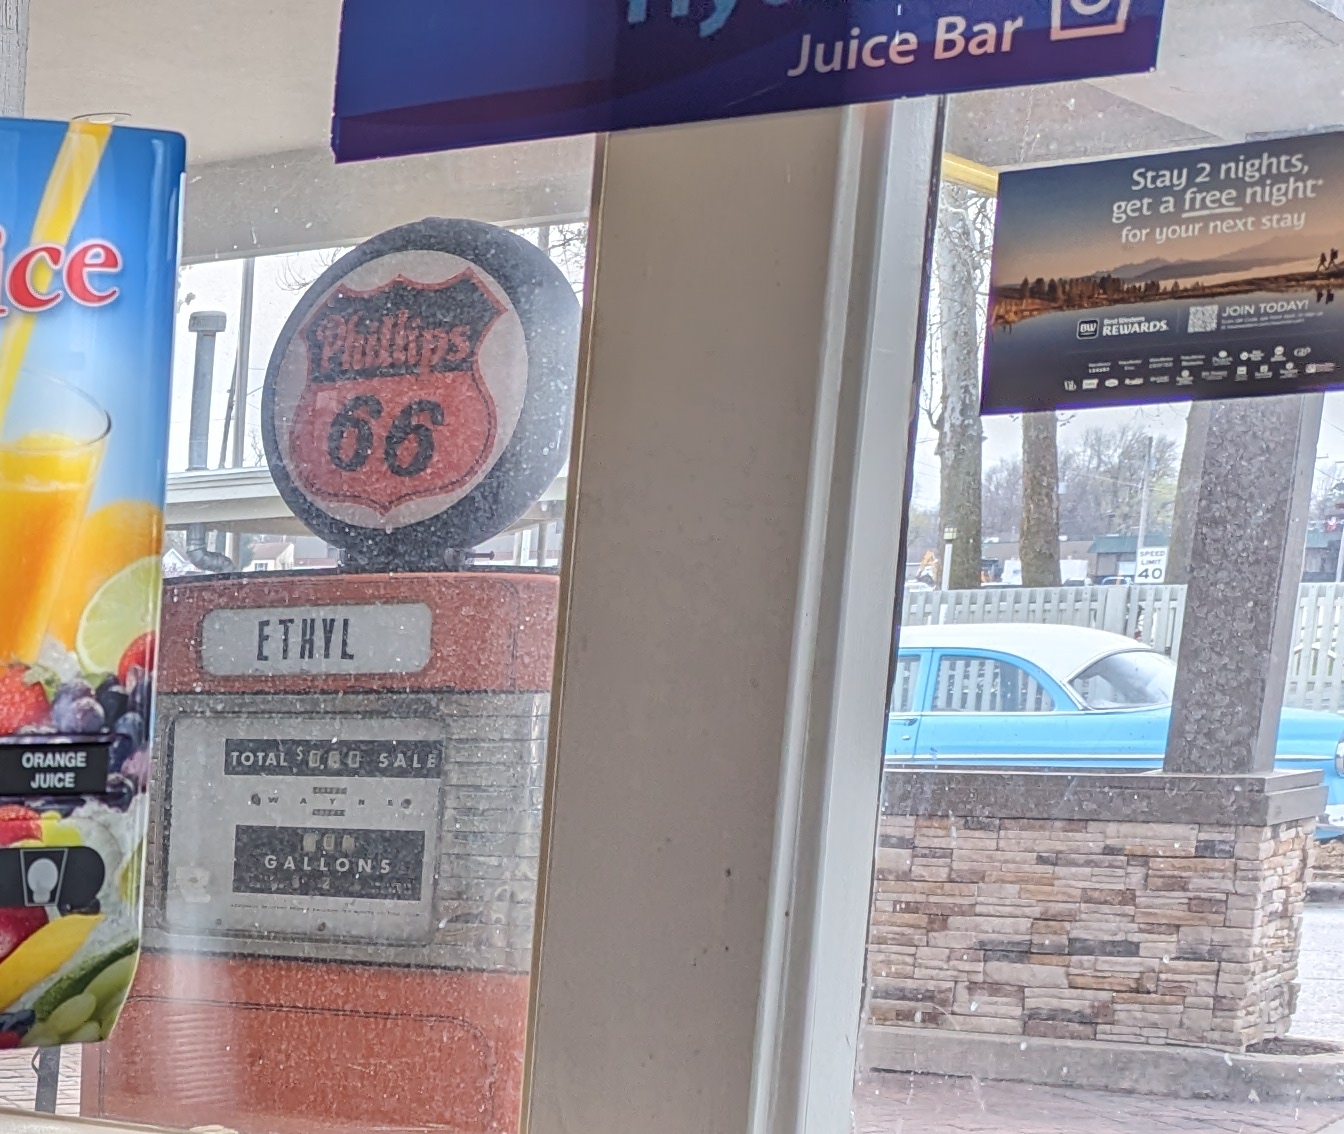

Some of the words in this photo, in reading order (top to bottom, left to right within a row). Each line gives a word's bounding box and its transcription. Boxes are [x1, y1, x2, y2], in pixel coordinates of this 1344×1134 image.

[787, 26, 919, 77] Juice
[933, 15, 1024, 60] Bar
[1131, 168, 1187, 191] Stay
[1195, 162, 1211, 183] 2
[1219, 152, 1310, 182] nights,
[1111, 196, 1153, 224] get
[1159, 196, 1175, 214] a
[1183, 187, 1237, 212] free
[1121, 226, 1150, 244] for
[1155, 221, 1203, 245] your
[1208, 217, 1255, 235] next
[1260, 211, 1306, 232] stay
[1221, 304, 1255, 318] JOIN
[1258, 299, 1310, 314] TODAY!
[1102, 320, 1169, 337] REWARDS
[315, 308, 472, 378] Phillips
[327, 394, 445, 478] 66
[1137, 567, 1163, 580] 40
[256, 618, 355, 662] ETHYL
[21, 751, 87, 769] ORANGE
[231, 751, 288, 767] TOTAL
[378, 753, 437, 768] SALE
[30, 772, 76, 790] JUICE
[264, 855, 391, 874] GALLONS
